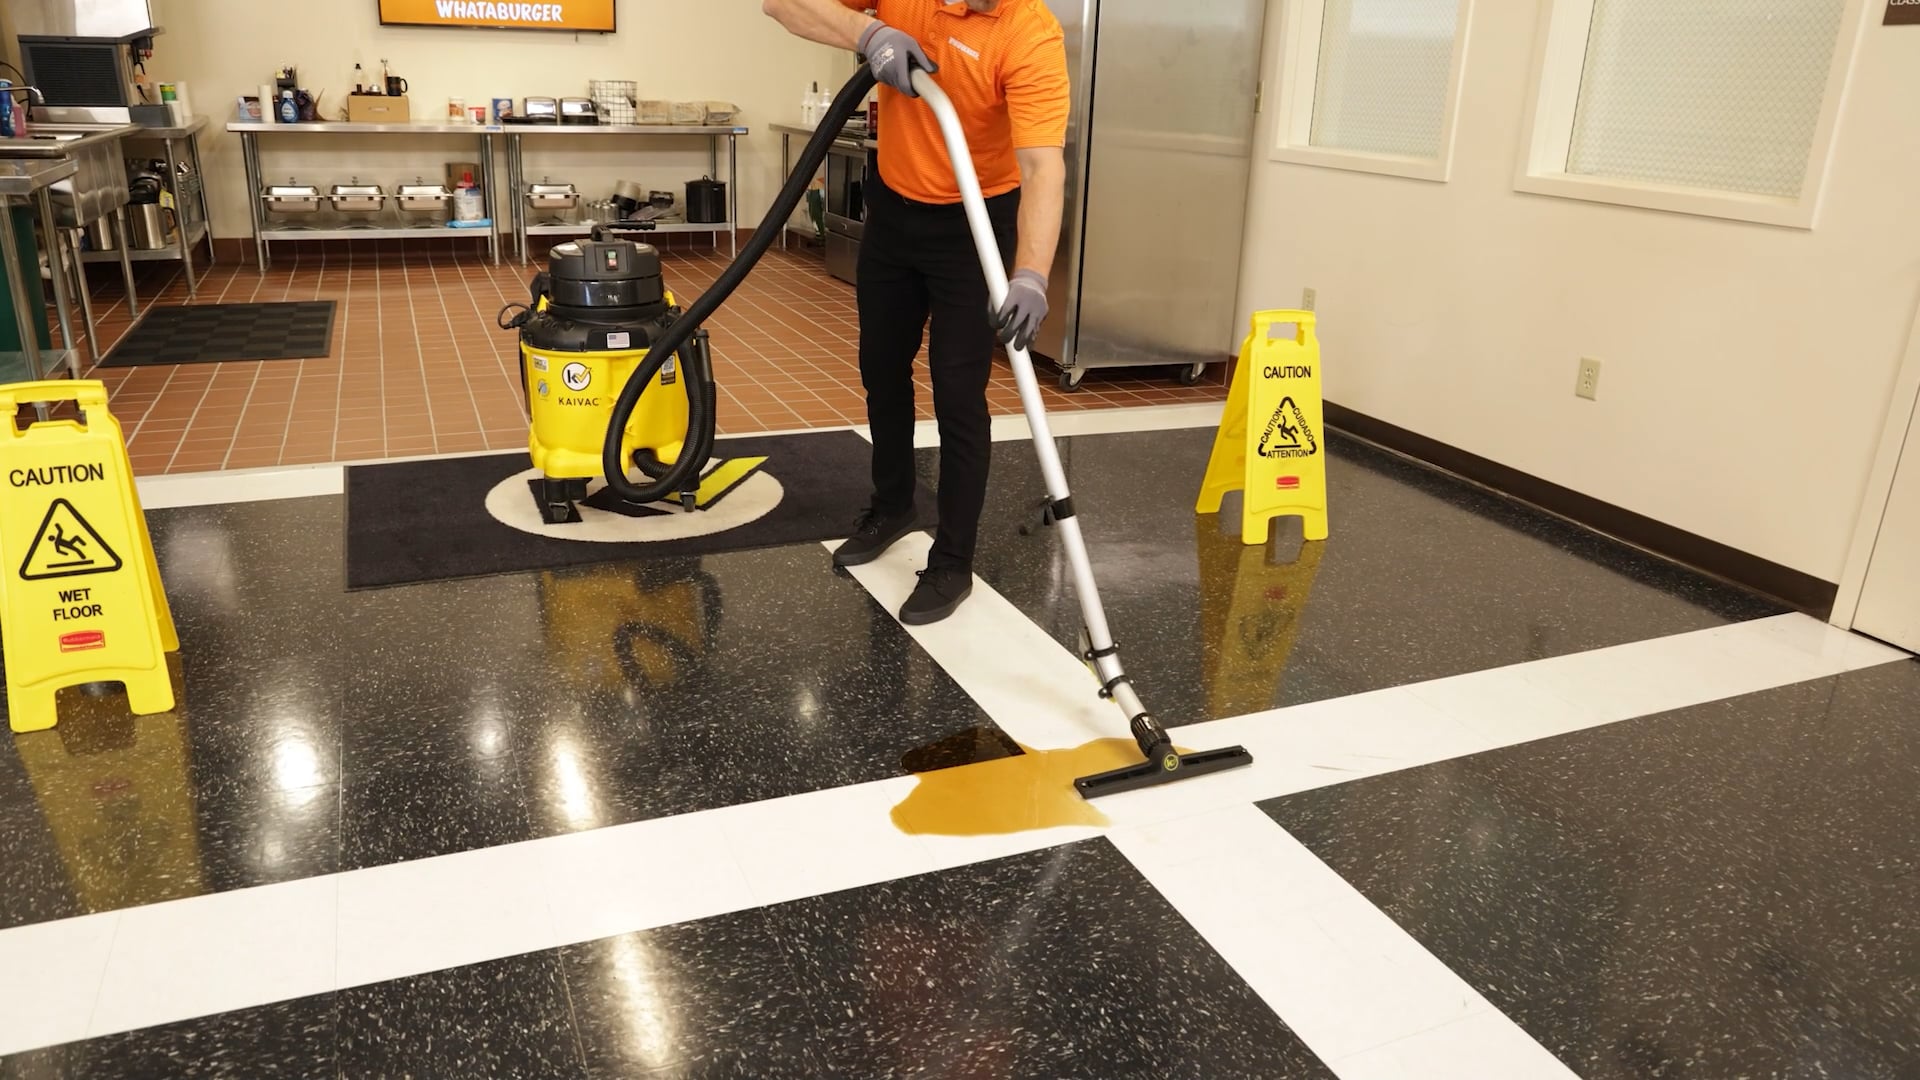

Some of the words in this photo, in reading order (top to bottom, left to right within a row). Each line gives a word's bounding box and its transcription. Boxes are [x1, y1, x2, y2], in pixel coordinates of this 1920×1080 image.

[435, 0, 563, 22] WHATABURGER
[1263, 366, 1311, 379] CAUTION
[558, 397, 600, 406] KAIVAC
[1260, 408, 1283, 444] CAUTION
[1292, 407, 1314, 442] CUIDADO
[1266, 449, 1309, 459] ATTENTION
[9, 463, 104, 487] CAUTION
[58, 588, 91, 603] WET
[53, 604, 103, 621] FLOOR
